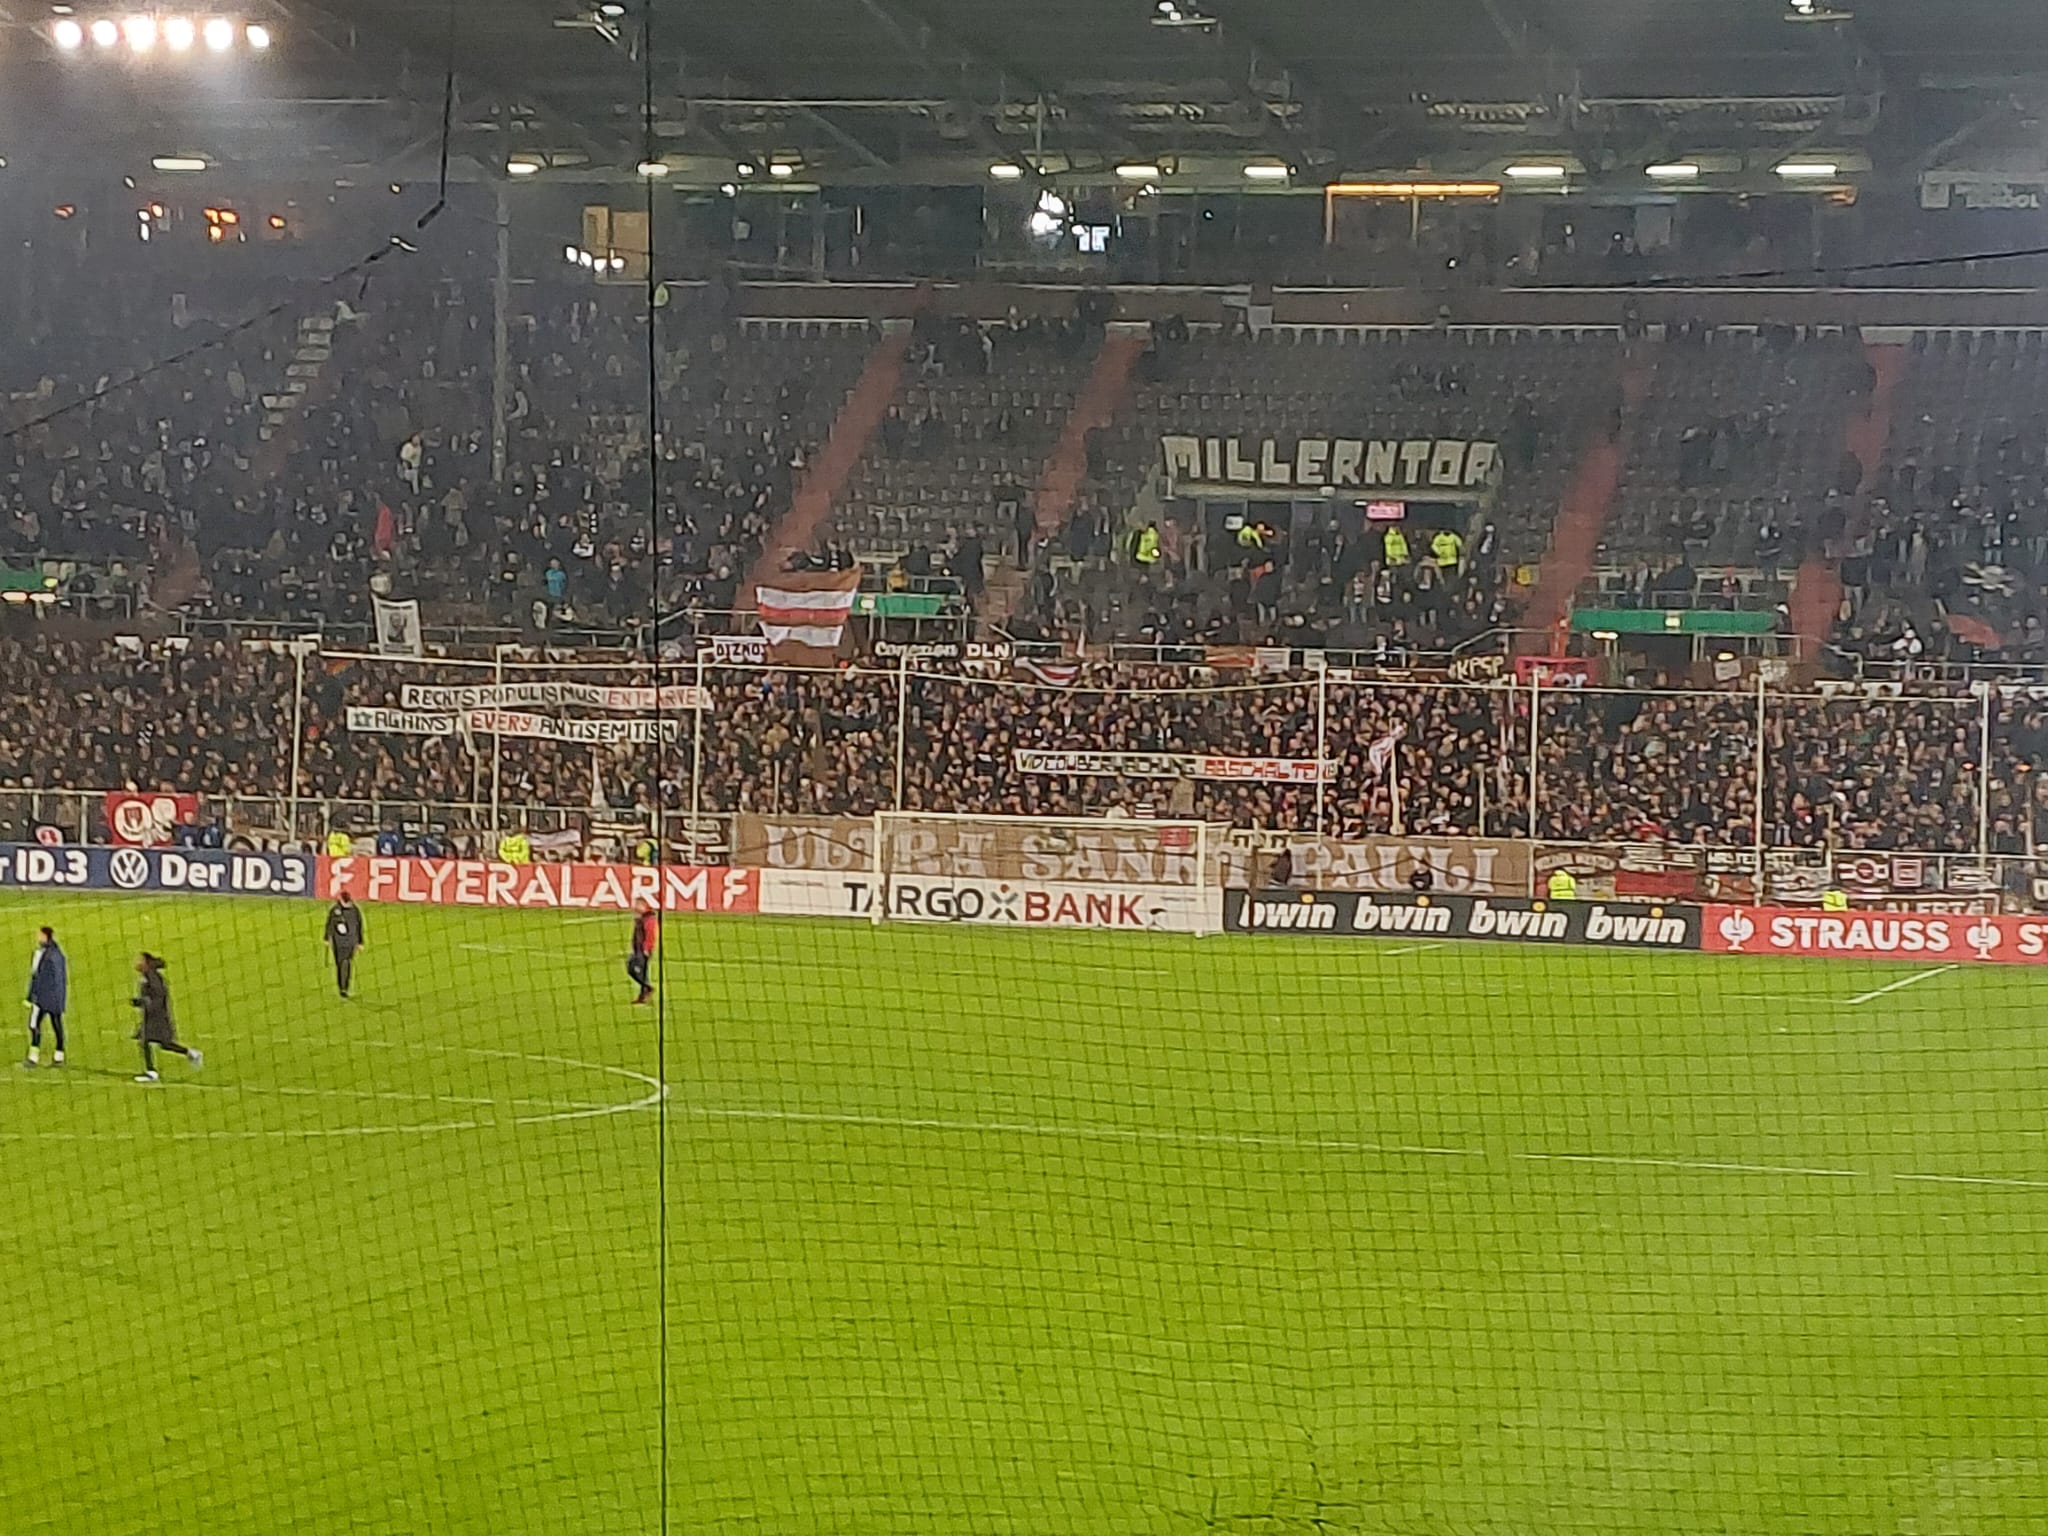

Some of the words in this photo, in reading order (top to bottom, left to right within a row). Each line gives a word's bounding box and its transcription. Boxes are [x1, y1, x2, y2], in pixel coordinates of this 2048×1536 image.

[1162, 434, 1497, 486] MILLERNTOR
[472, 712, 531, 731] EVERY
[16, 849, 88, 884] ID.3
[161, 854, 225, 880] Der
[233, 857, 306, 892] ID.3
[368, 858, 708, 910] FLYERALARM
[1238, 893, 1336, 929] bwin
[1353, 895, 1452, 933] bwin
[1469, 900, 1568, 939] bwin
[1585, 905, 1687, 944] bwin
[1770, 916, 1951, 952] STRAUSS
